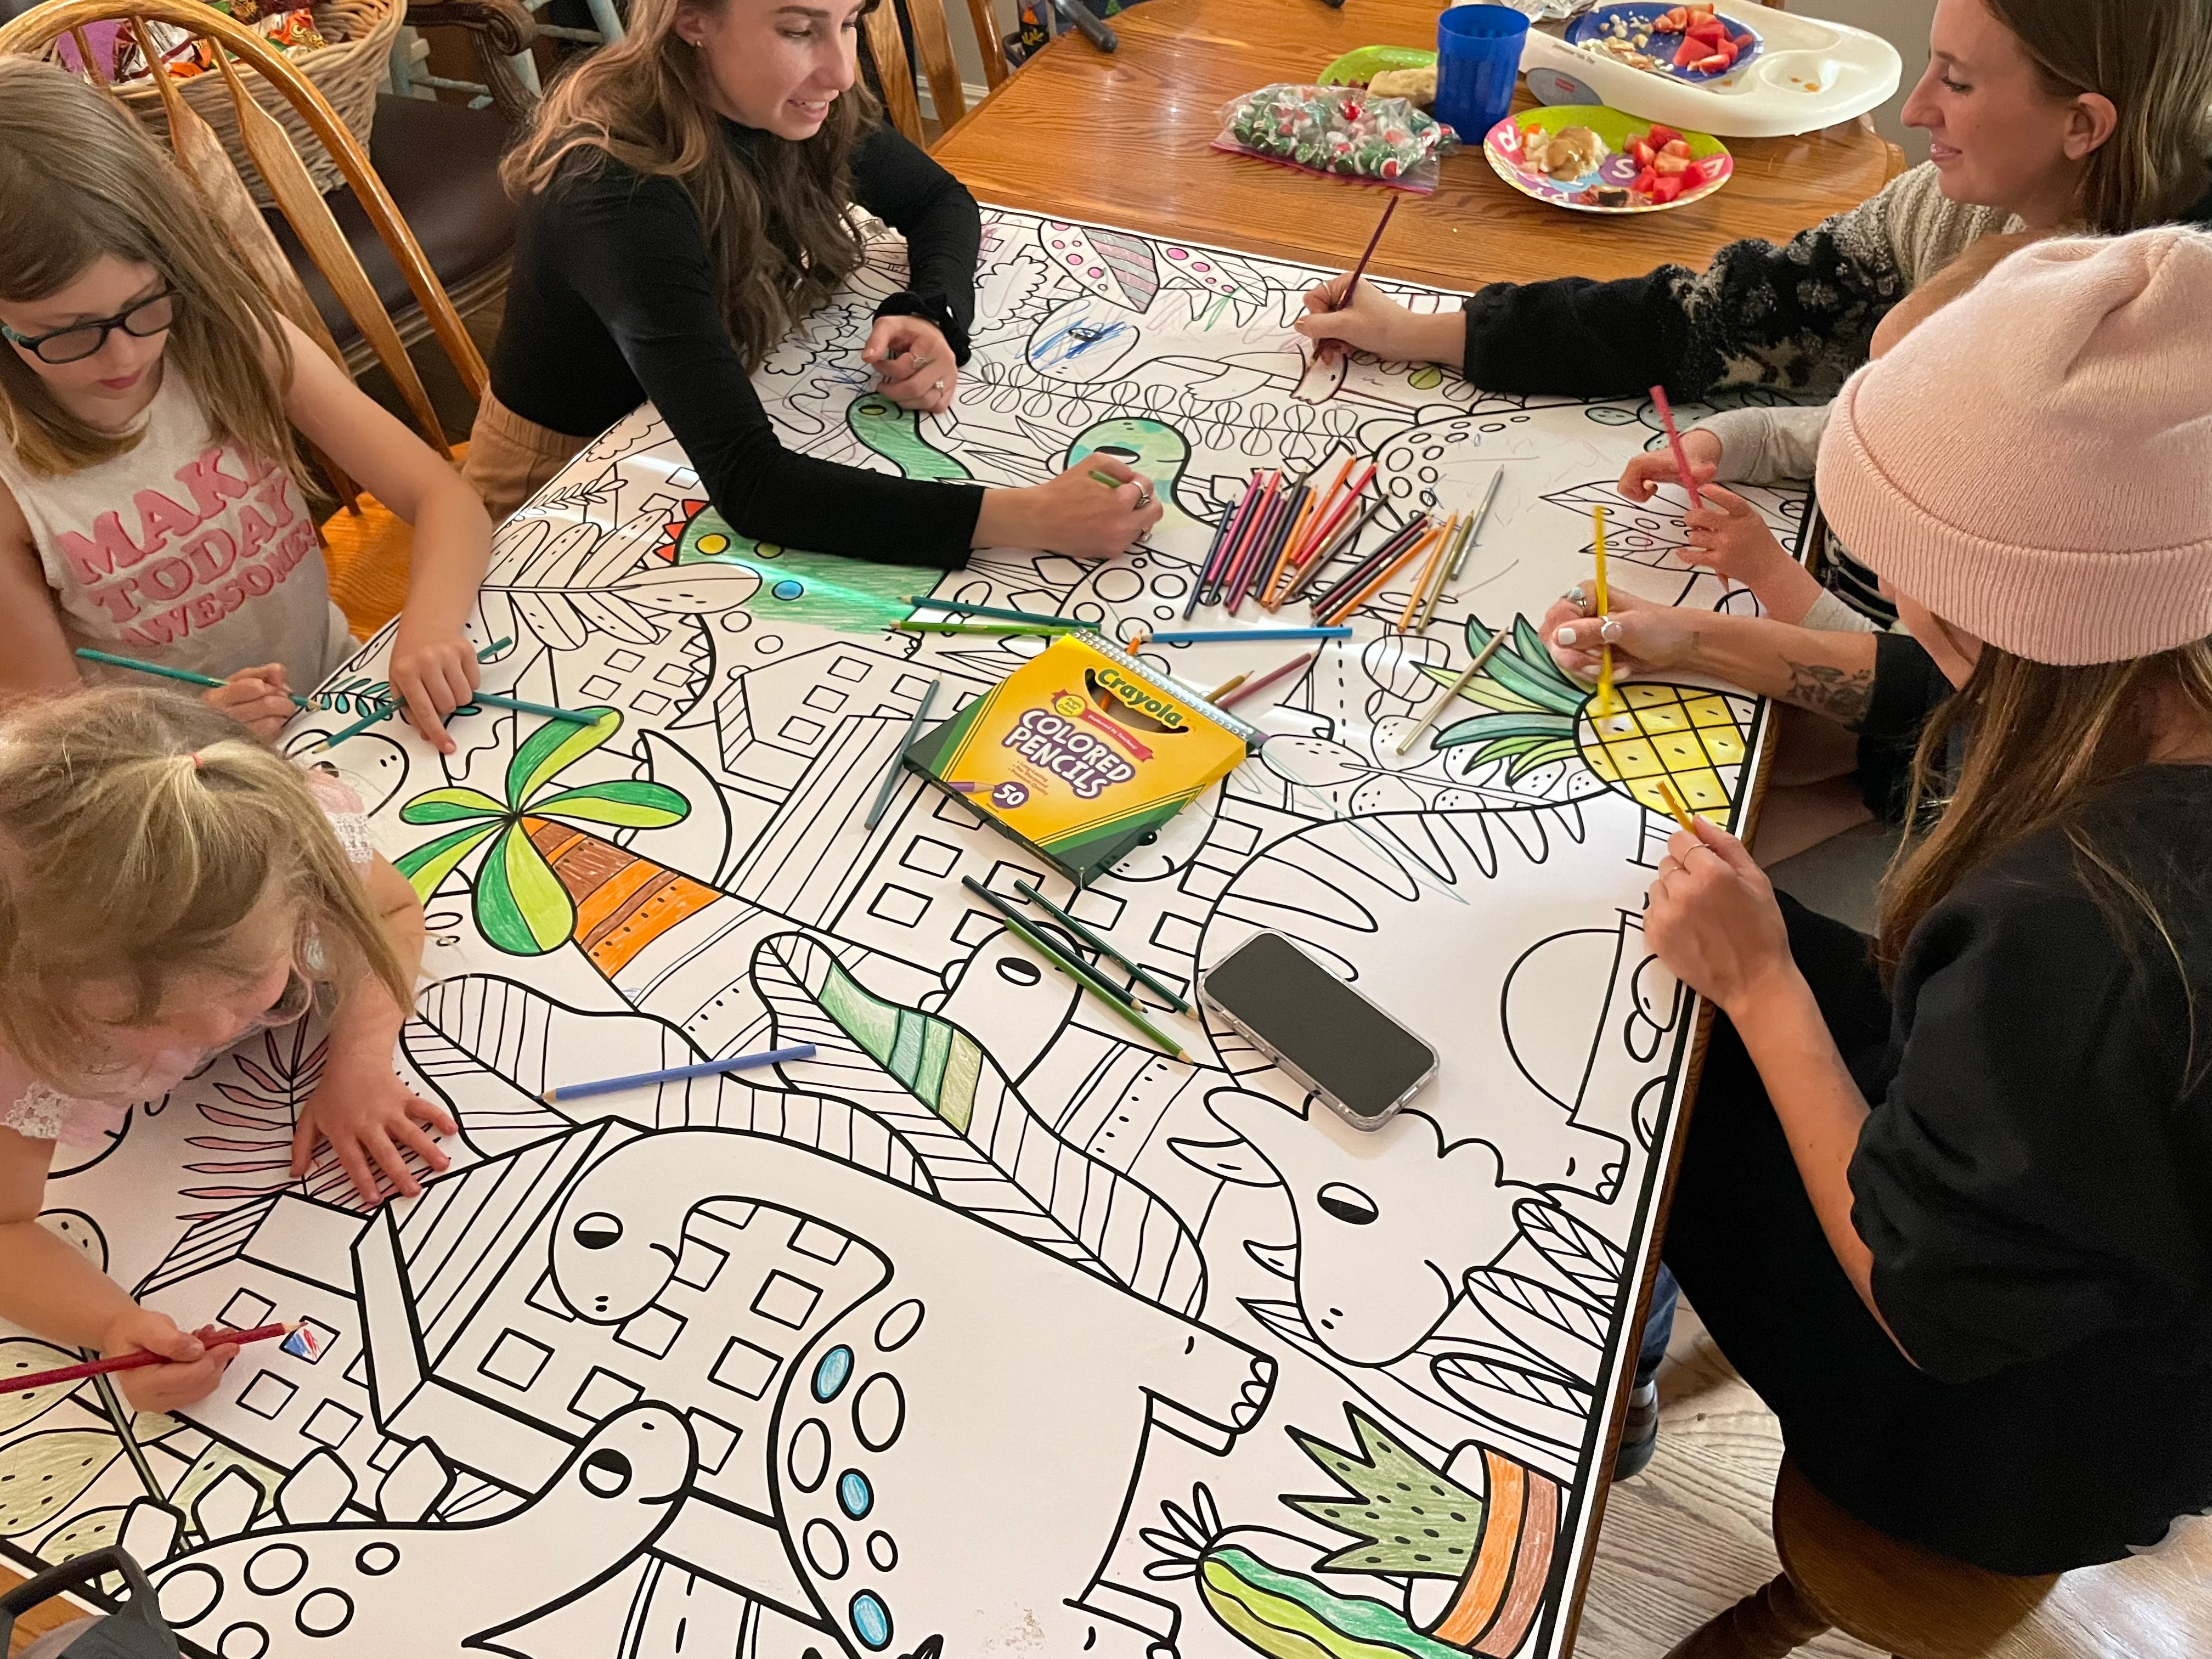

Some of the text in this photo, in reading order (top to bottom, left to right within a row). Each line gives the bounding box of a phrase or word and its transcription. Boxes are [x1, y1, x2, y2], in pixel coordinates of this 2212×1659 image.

[87, 475, 294, 623] TODAY
[1098, 669, 1183, 726] Crayola
[1005, 726, 1108, 798] PENCILS
[1022, 710, 1132, 781] COLORED
[993, 783, 1025, 805] 50
